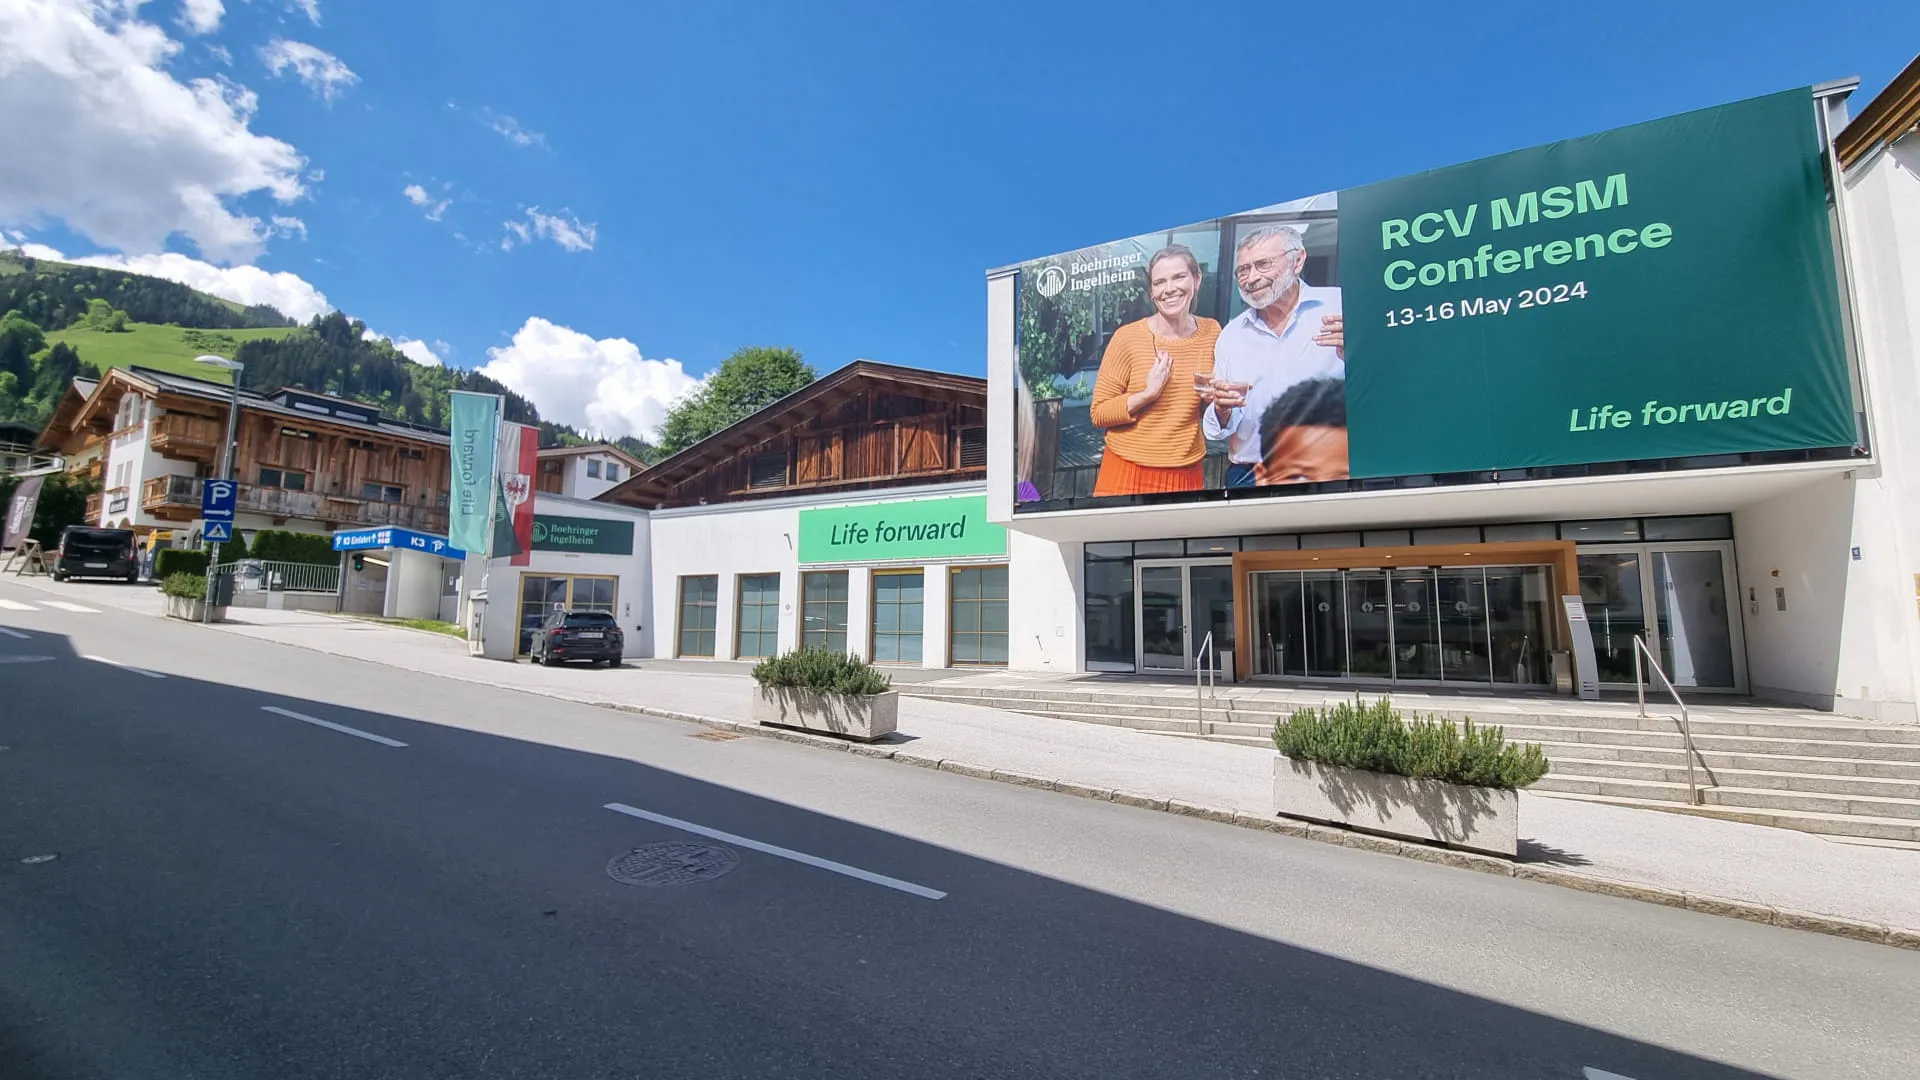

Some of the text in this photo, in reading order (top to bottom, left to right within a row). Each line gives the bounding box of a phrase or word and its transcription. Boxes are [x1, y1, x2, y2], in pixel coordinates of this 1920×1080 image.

[1381, 173, 1629, 250] RCV MSM
[1071, 252, 1143, 275] Boehringer
[1383, 222, 1673, 291] Conference
[1070, 269, 1136, 291] Ingelheim
[1386, 281, 1589, 328] 13-16 May 2024
[1569, 387, 1793, 432] Life forward
[211, 486, 231, 505] P
[550, 523, 600, 537] Boehringer
[550, 533, 595, 546] Ingelheim
[830, 514, 967, 546] Life forward
[410, 536, 426, 548] K3
